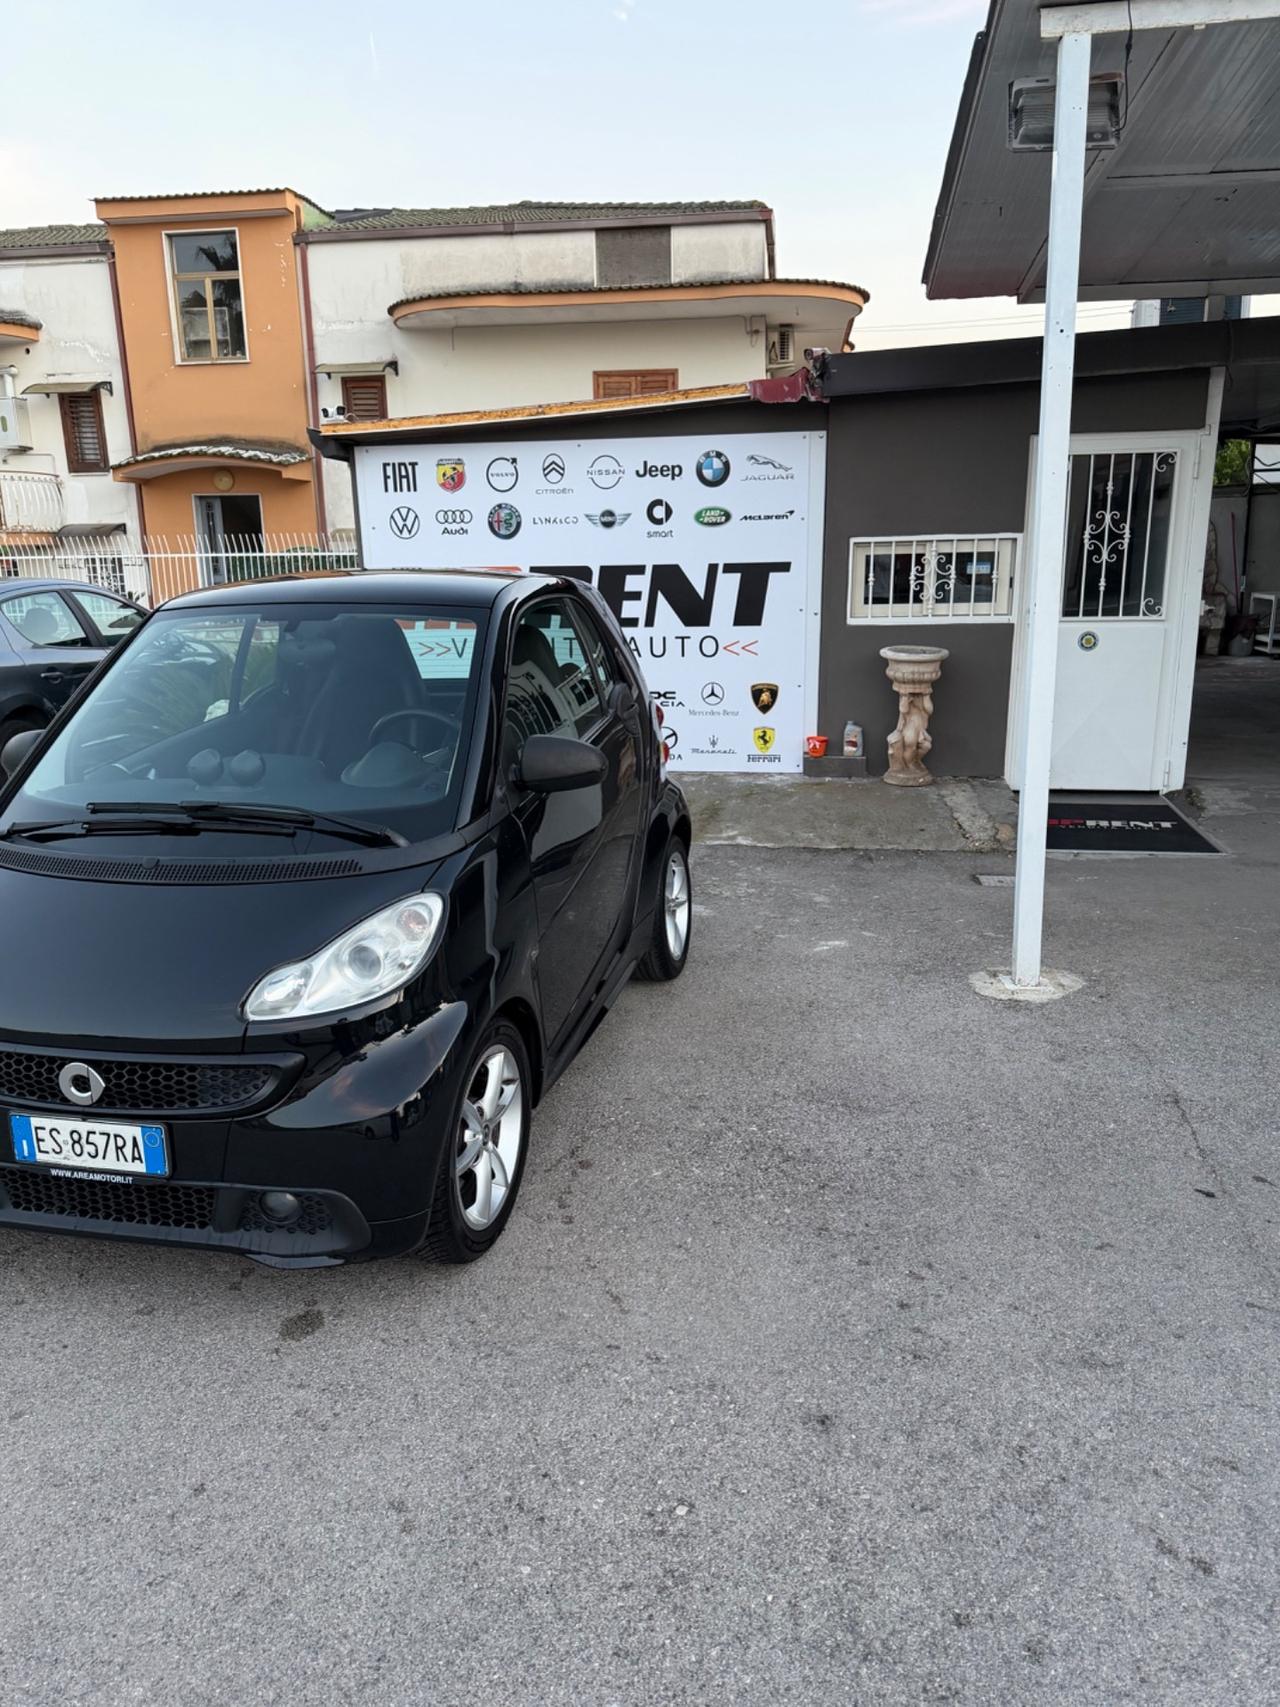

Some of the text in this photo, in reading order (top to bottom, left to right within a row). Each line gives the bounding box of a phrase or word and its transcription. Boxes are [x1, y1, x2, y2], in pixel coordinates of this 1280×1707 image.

[586, 468, 625, 476] NISSAN
[635, 460, 683, 480] Jeep
[382, 462, 419, 492] FIAT
[740, 473, 794, 481] JAGUAR
[702, 509, 719, 517] LAND
[740, 513, 790, 521] McLaren
[703, 516, 726, 524] ROVER
[441, 527, 469, 536] Audi
[646, 529, 674, 538] smart
[688, 708, 740, 717] Mercedes-Benz
[747, 754, 781, 763] Ferrari
[50, 1168, 133, 1184] WWW.AREAMOTORI.IT
